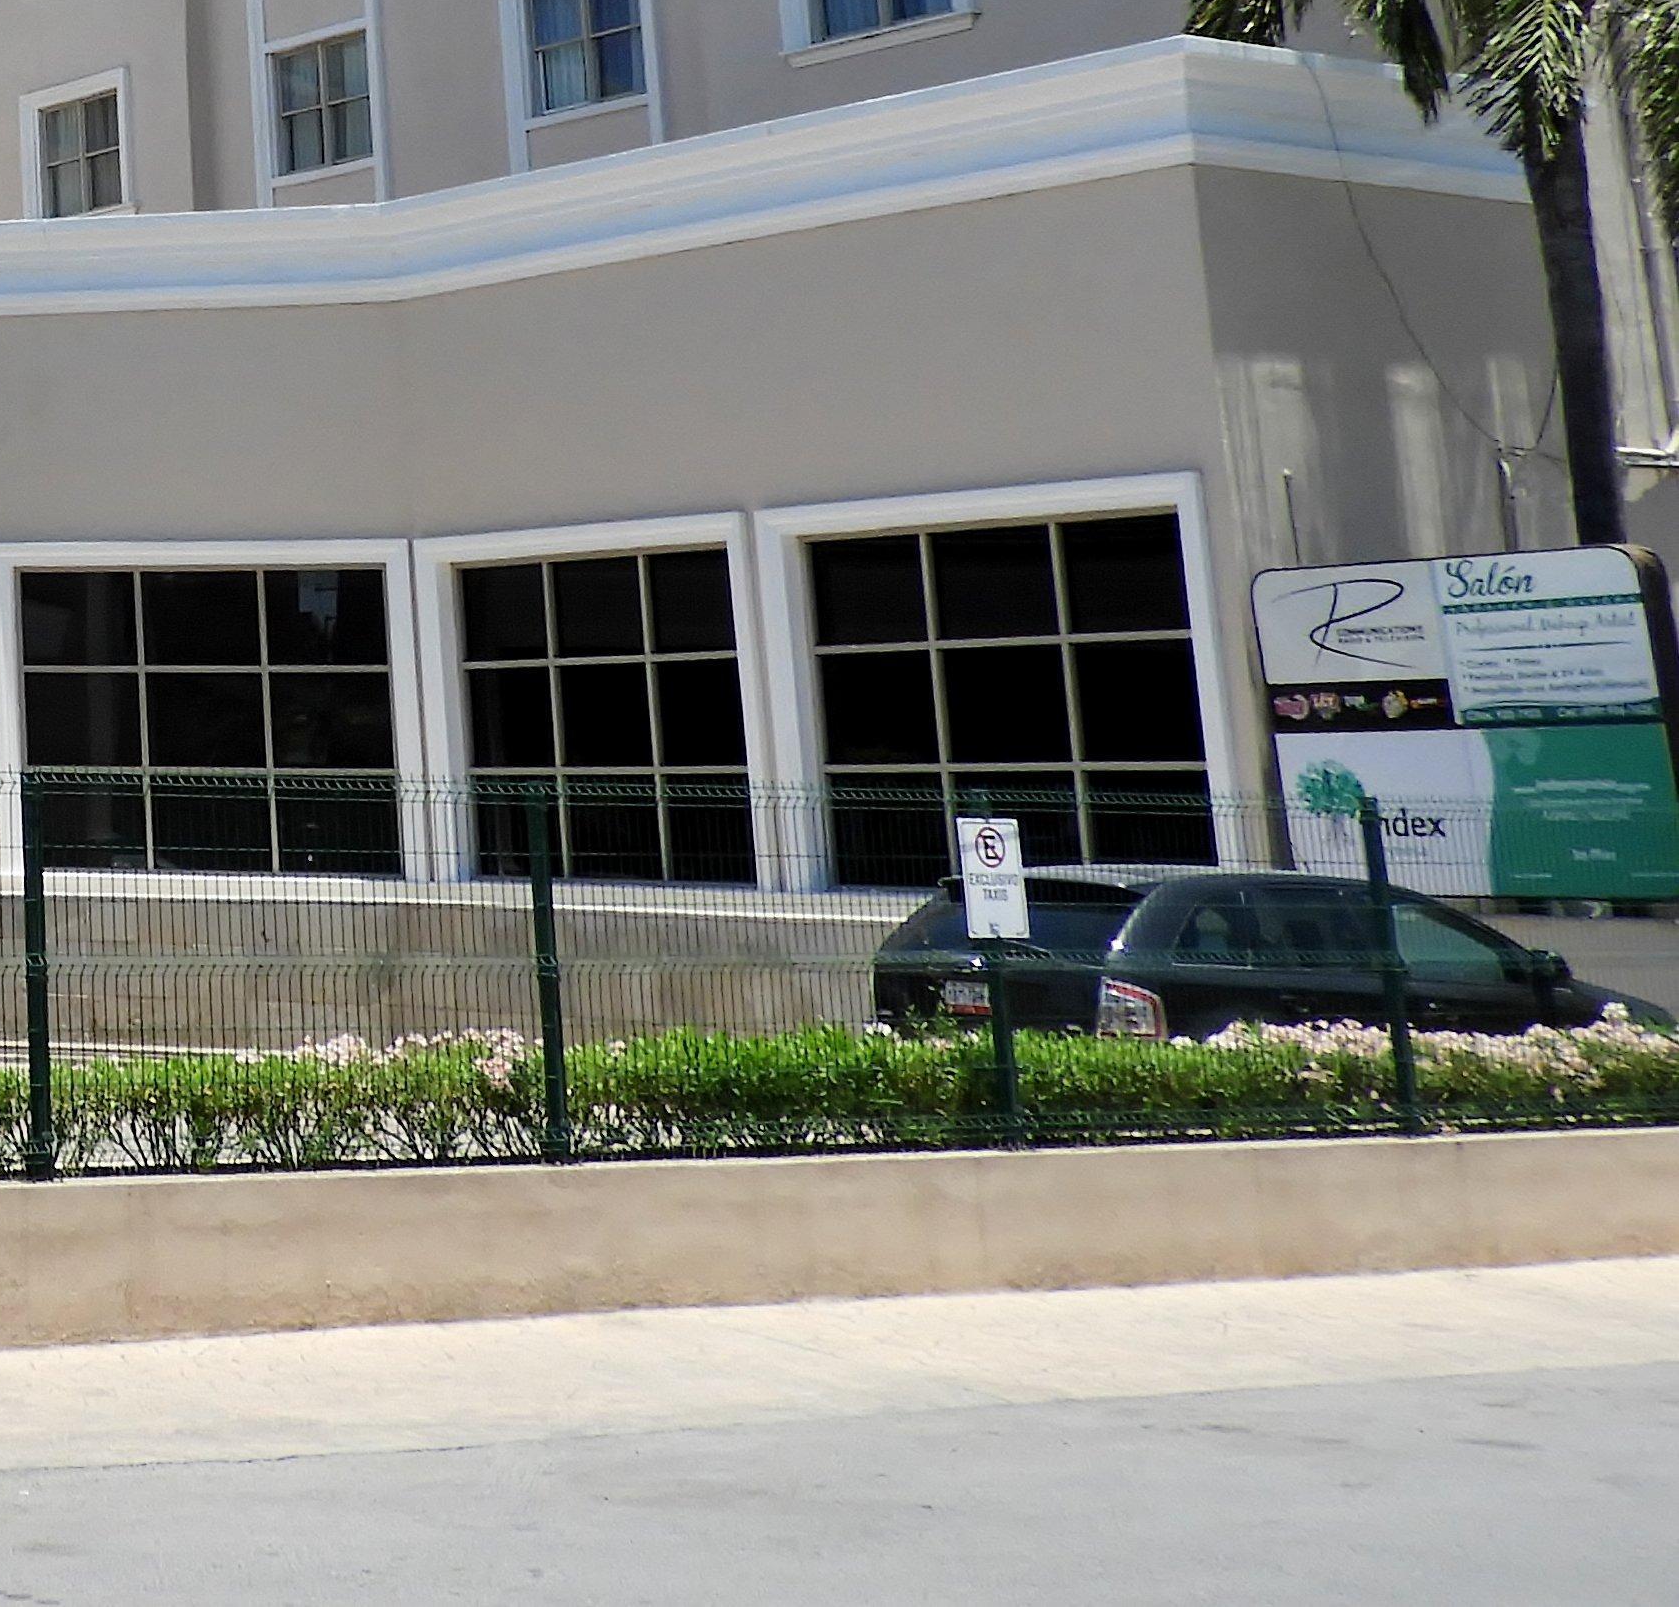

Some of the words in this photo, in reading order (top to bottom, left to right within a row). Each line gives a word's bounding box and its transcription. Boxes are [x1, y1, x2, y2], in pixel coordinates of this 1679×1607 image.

[1446, 559, 1533, 598] Salón
[969, 873, 1019, 886] EXCLUSIVO
[982, 888, 1008, 901] TAXIS
